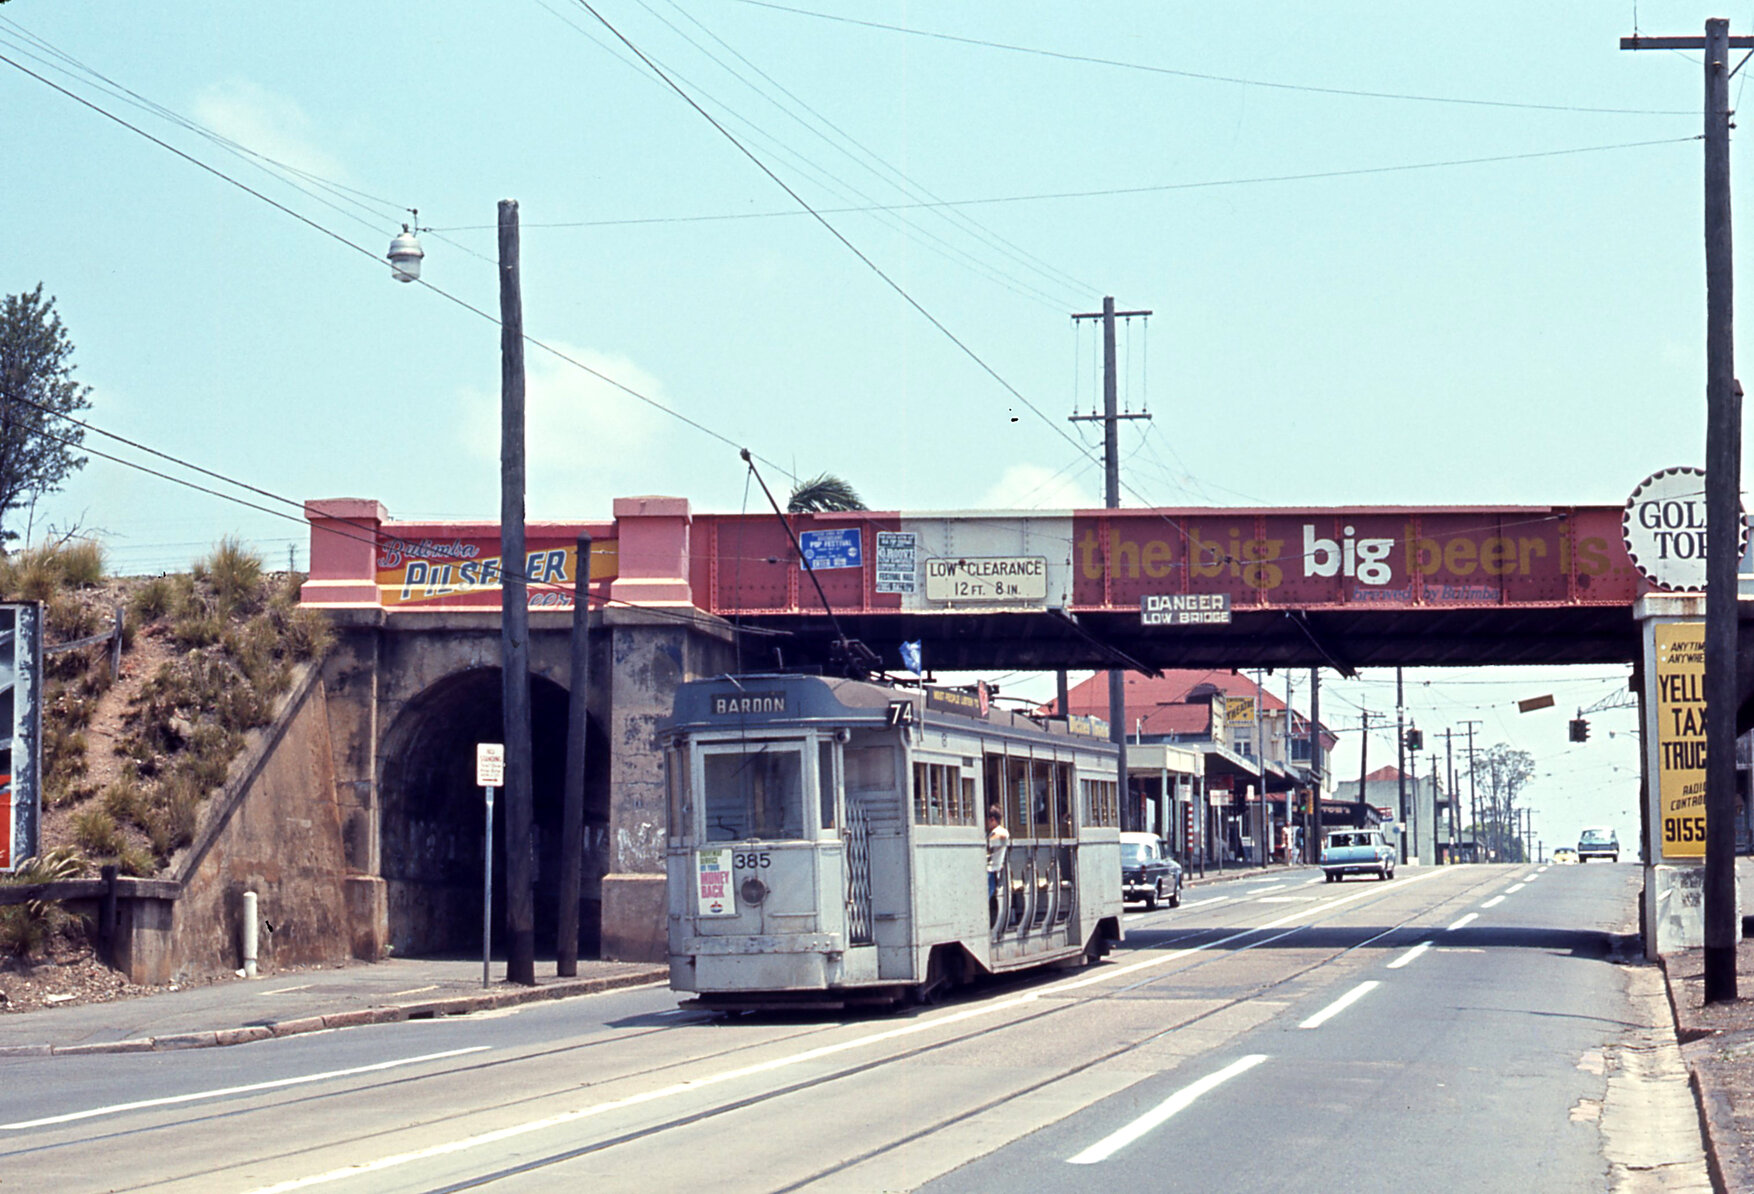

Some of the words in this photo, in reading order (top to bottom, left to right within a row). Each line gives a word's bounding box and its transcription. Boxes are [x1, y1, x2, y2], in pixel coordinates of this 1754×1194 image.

[1639, 501, 1707, 529] GOL
[1078, 528, 1172, 579] the
[1189, 528, 1285, 589] big
[1303, 524, 1395, 585] big
[1404, 523, 1546, 576] beer
[400, 550, 568, 600] PILSEER
[930, 563, 956, 577] LOW
[967, 561, 1042, 576] CLEARANCE
[955, 582, 968, 596] 12
[995, 581, 1004, 595] 8
[527, 591, 572, 606] eer
[1147, 595, 1224, 611] DANGER
[1143, 612, 1172, 624] LOW
[1179, 611, 1229, 623] BRIDGE
[716, 698, 785, 714] BARDON
[890, 703, 912, 725] 74
[1672, 707, 1708, 736] TAX
[1662, 741, 1706, 770] TRUC
[1665, 817, 1706, 842] 9155
[735, 852, 771, 869] 385
